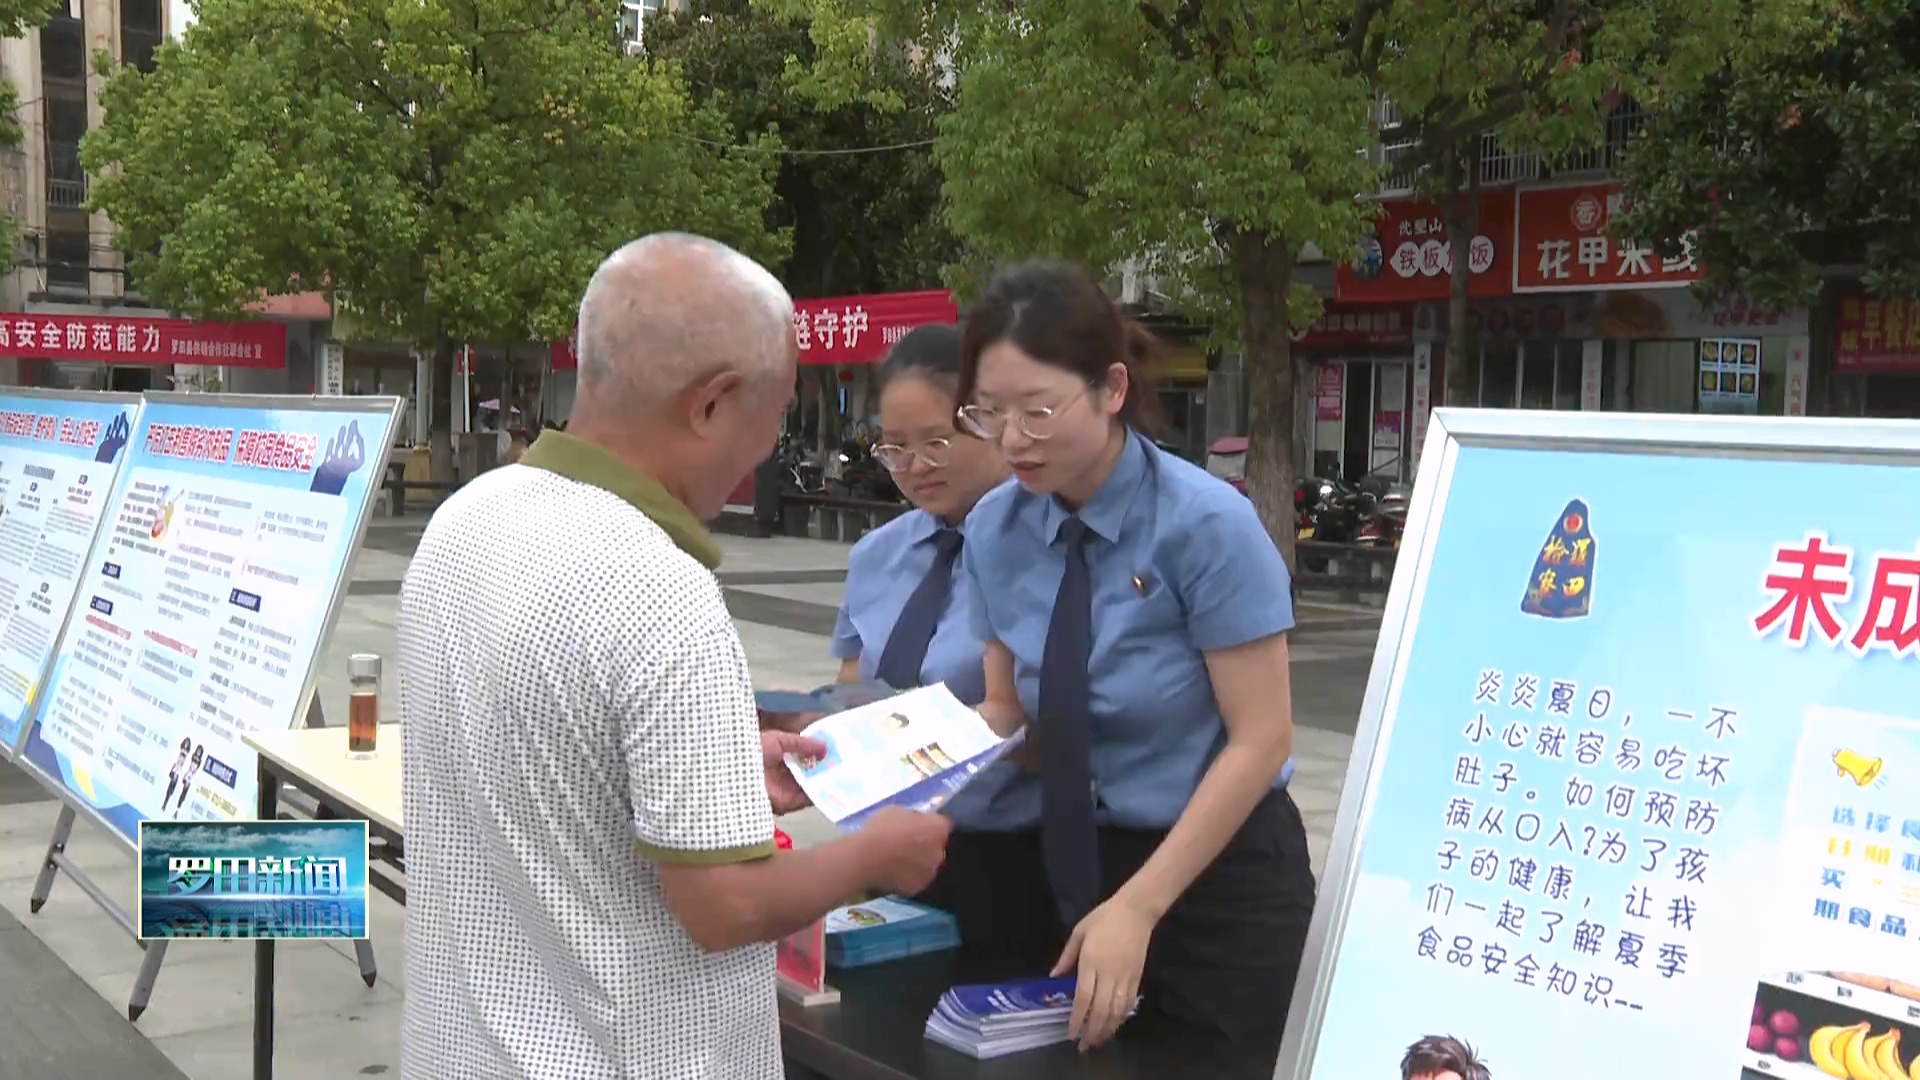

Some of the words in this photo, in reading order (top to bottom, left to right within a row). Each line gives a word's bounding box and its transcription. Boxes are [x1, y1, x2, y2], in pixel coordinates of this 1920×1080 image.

[1399, 242, 1489, 272] 铁板饭
[1465, 713, 1731, 787] 小心就容易吃坏
[1455, 757, 1720, 836] 肚子。如何预防
[1426, 882, 1689, 979] 们一起了解夏季
